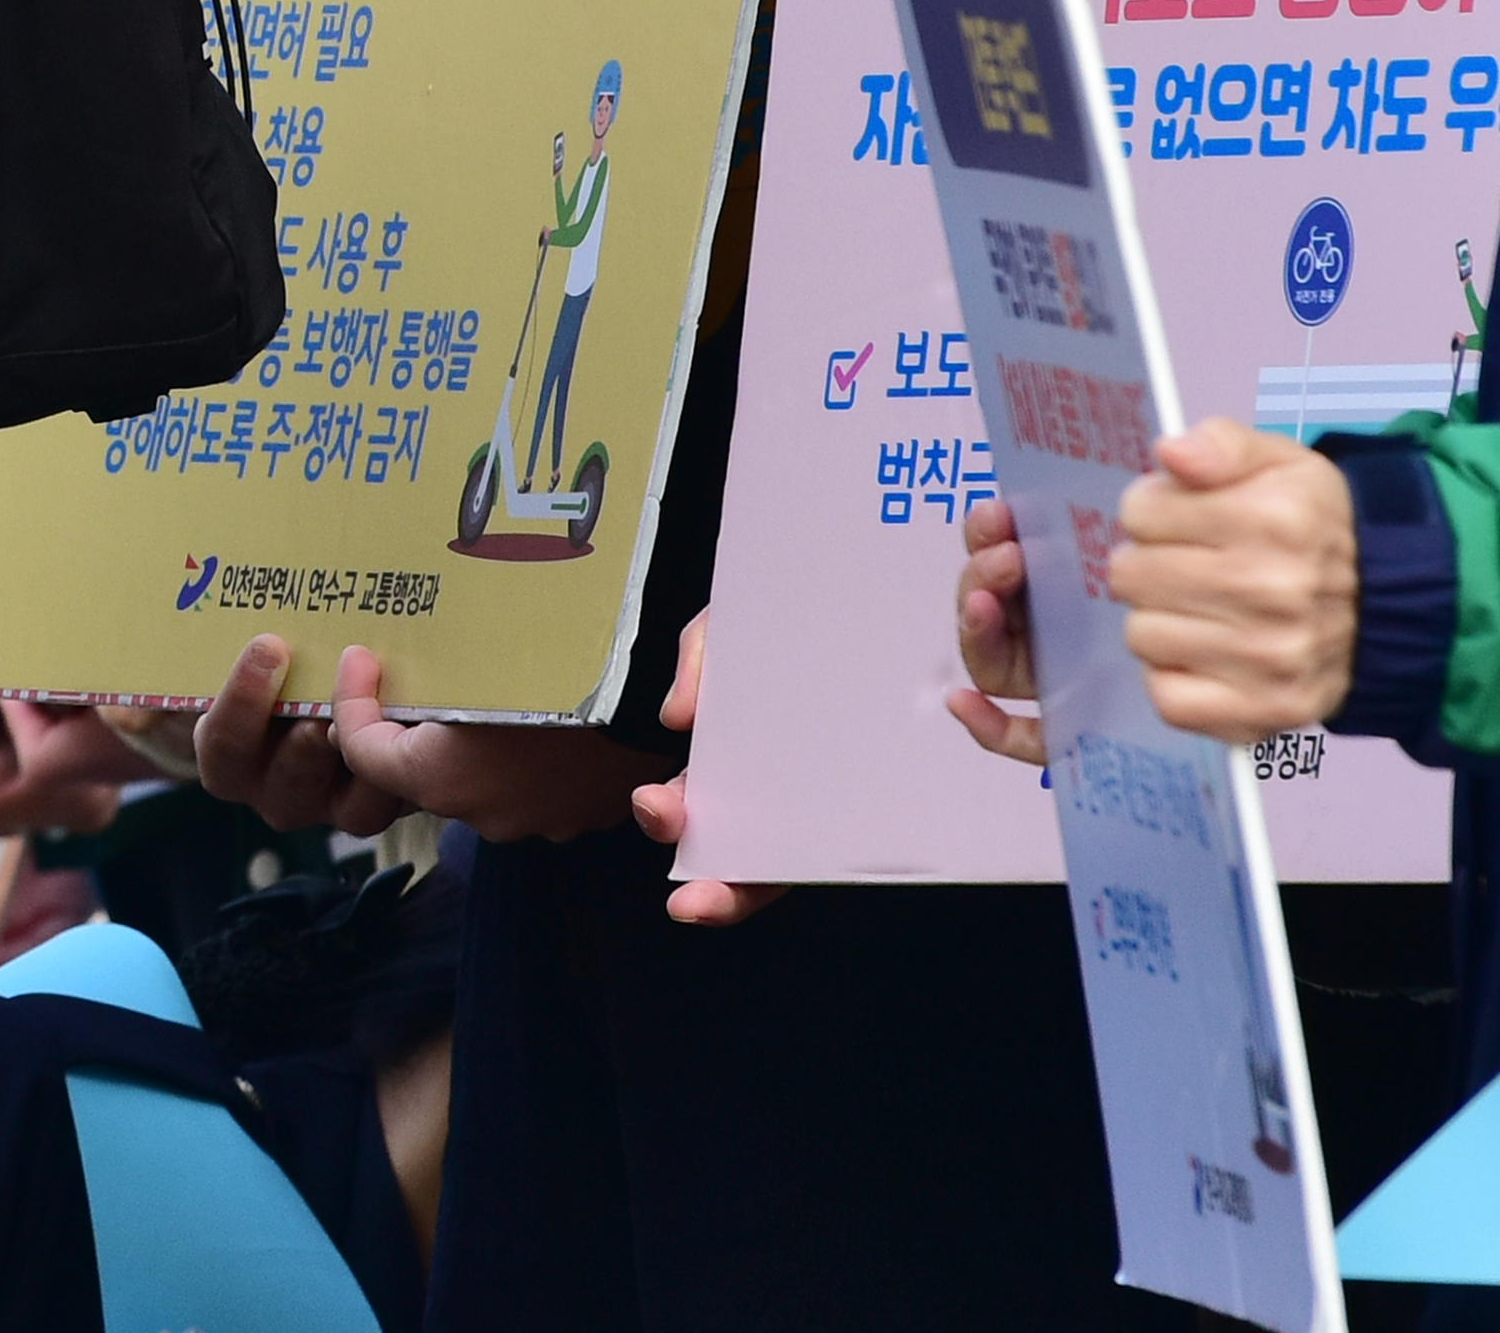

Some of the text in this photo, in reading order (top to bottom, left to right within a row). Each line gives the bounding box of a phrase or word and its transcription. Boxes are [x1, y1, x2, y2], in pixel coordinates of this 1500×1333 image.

[314, 2, 373, 82] 필요
[264, 106, 325, 187] 착용
[1150, 61, 1312, 161] 없으면
[1322, 57, 1430, 154] 차도
[1445, 56, 1499, 153] 우
[307, 213, 370, 294] 사용
[373, 213, 409, 293] 후
[294, 308, 388, 386] 보행자
[391, 310, 479, 391] 통행을
[886, 331, 973, 397] 보도
[105, 396, 257, 479] 방해하도록
[365, 405, 429, 483] 금지
[877, 438, 998, 524] 범칙금
[219, 565, 441, 617] 인천광역시 연수구 교통행정과
[1254, 733, 1325, 780] 행정과
